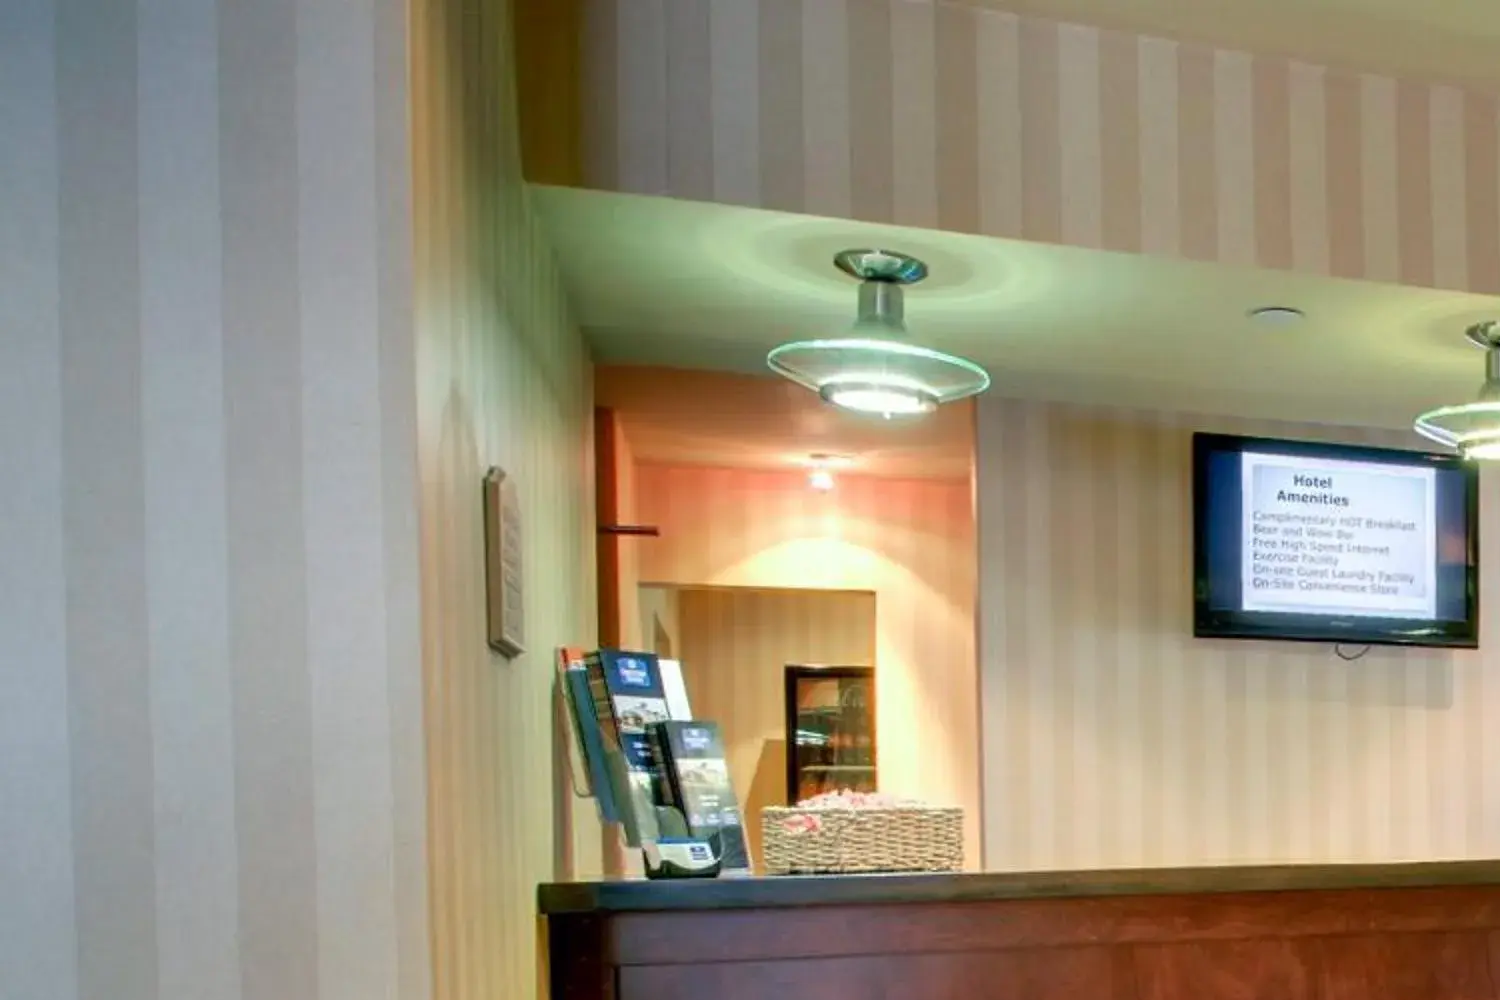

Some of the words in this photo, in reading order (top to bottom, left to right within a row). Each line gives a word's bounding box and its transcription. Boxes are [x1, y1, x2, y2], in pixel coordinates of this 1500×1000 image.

[1293, 474, 1333, 489] Hotel
[1276, 490, 1350, 507] Amenities
[1280, 526, 1303, 537] and
[1253, 536, 1278, 548] Free
[1281, 540, 1306, 552] High
[1253, 551, 1299, 563] Exercise
